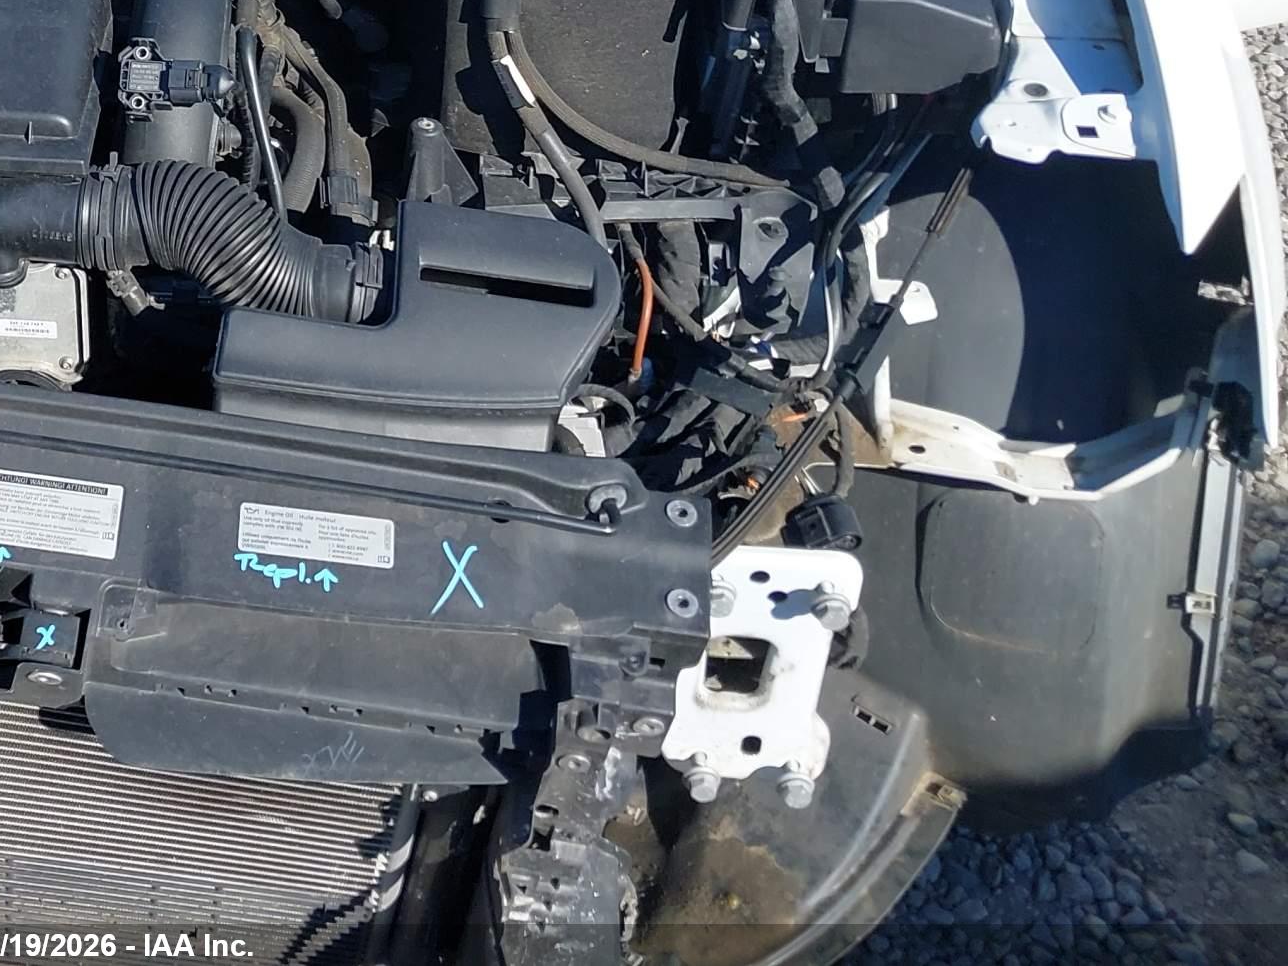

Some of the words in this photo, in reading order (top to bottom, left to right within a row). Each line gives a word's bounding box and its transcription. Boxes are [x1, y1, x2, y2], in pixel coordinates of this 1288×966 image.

[65, 483, 105, 494] ATTENTION!
[234, 552, 312, 589] Repl.
[431, 540, 484, 616] X
